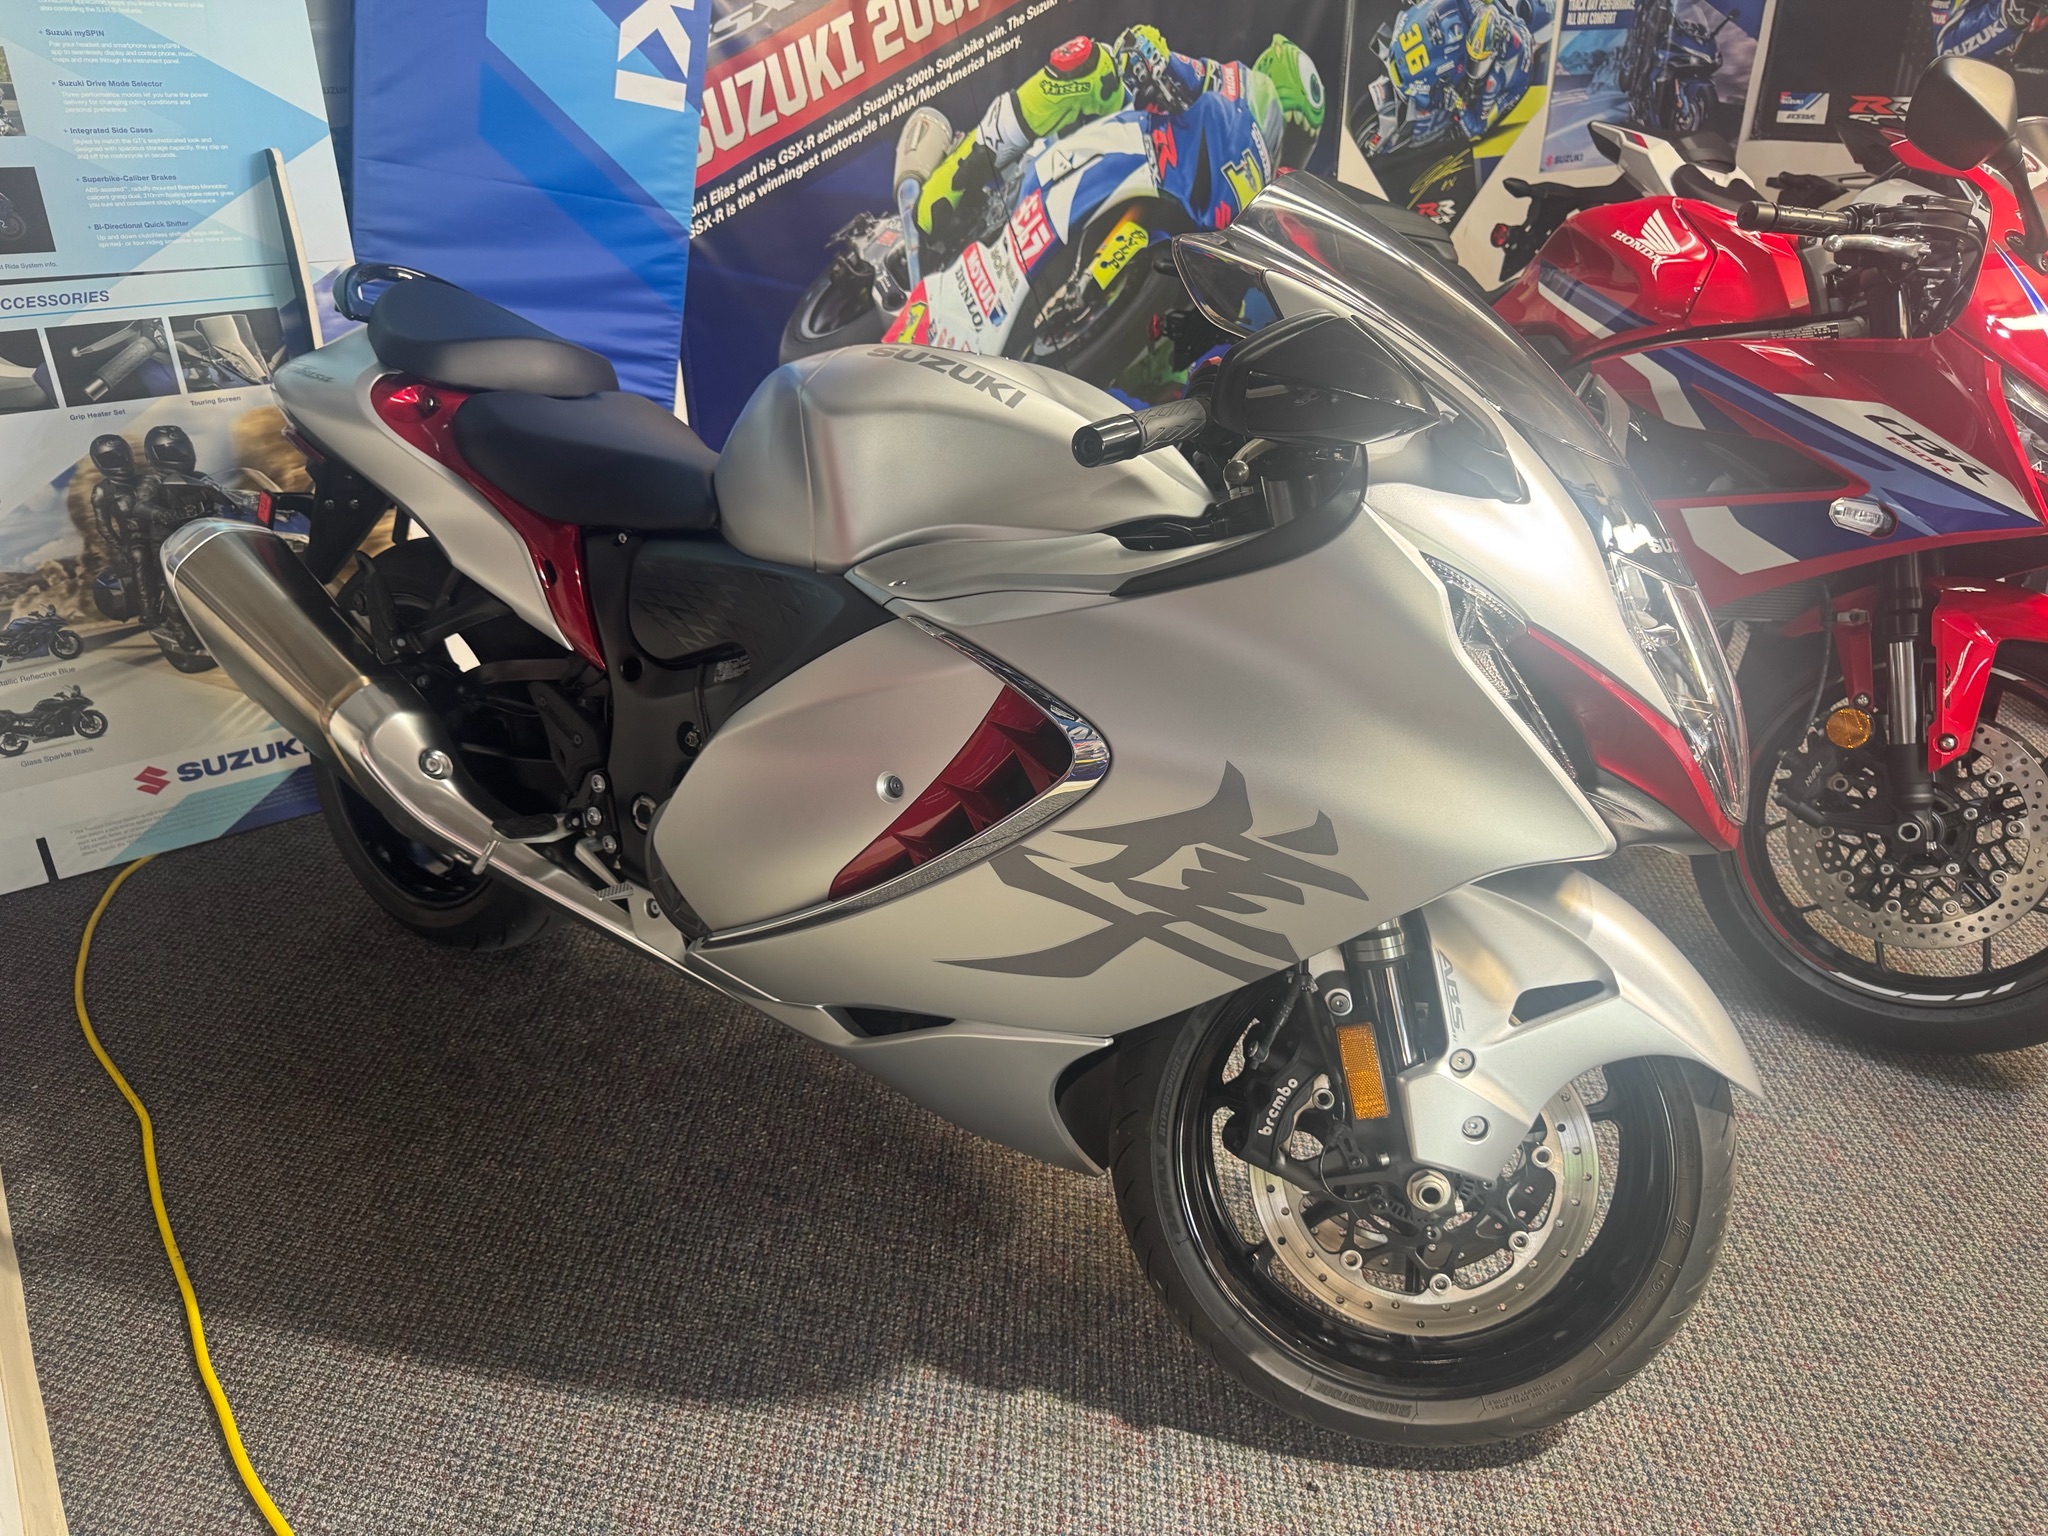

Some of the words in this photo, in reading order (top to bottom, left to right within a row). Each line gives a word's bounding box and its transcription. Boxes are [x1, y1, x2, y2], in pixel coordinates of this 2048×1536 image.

[1566, 12, 1576, 26] ALL
[1576, 12, 1588, 25] DAY
[1589, 11, 1618, 25] COMFORT
[45, 28, 73, 36] Suzuki
[74, 29, 105, 37] mySPIN
[1399, 22, 1431, 76] 36
[58, 79, 85, 87] Suzuki
[709, 181, 737, 207] Elias
[737, 168, 758, 191] and
[759, 157, 777, 177] his
[778, 134, 816, 165] GSX-R
[816, 106, 862, 145] achieved
[862, 81, 905, 117] Suzuki's
[905, 62, 935, 91] 200th
[935, 34, 985, 74] Superbike
[985, 25, 1007, 47] win.
[1007, 13, 1026, 32] The
[70, 127, 110, 135] Integrated
[726, 199, 738, 218] is
[738, 191, 757, 210] the
[756, 156, 820, 197] winningest
[820, 121, 879, 162] motorcycle
[879, 112, 890, 128] in
[890, 58, 985, 120] AMA/MotoAmerica
[985, 34, 1022, 64] history.
[1553, 153, 1585, 165] SUZUKI
[82, 175, 150, 183] Superbike-Caliber
[94, 222, 143, 230] Bi-Directional
[1611, 229, 1666, 264] HONDA
[20, 262, 44, 270] System
[867, 346, 1028, 409] SUZUKI
[190, 397, 217, 407] Touring
[217, 395, 242, 404] Screen
[69, 413, 86, 421] Grip
[87, 410, 113, 419] Heater
[113, 408, 127, 416] Set
[1863, 413, 1990, 488] CBR
[20, 669, 58, 683] Reflective
[58, 666, 76, 675] Blue
[20, 758, 43, 769] Glass
[43, 752, 73, 764] Sparkle
[73, 746, 95, 757] Black
[176, 737, 307, 782] SUZUK
[1257, 1077, 1298, 1136] brembo
